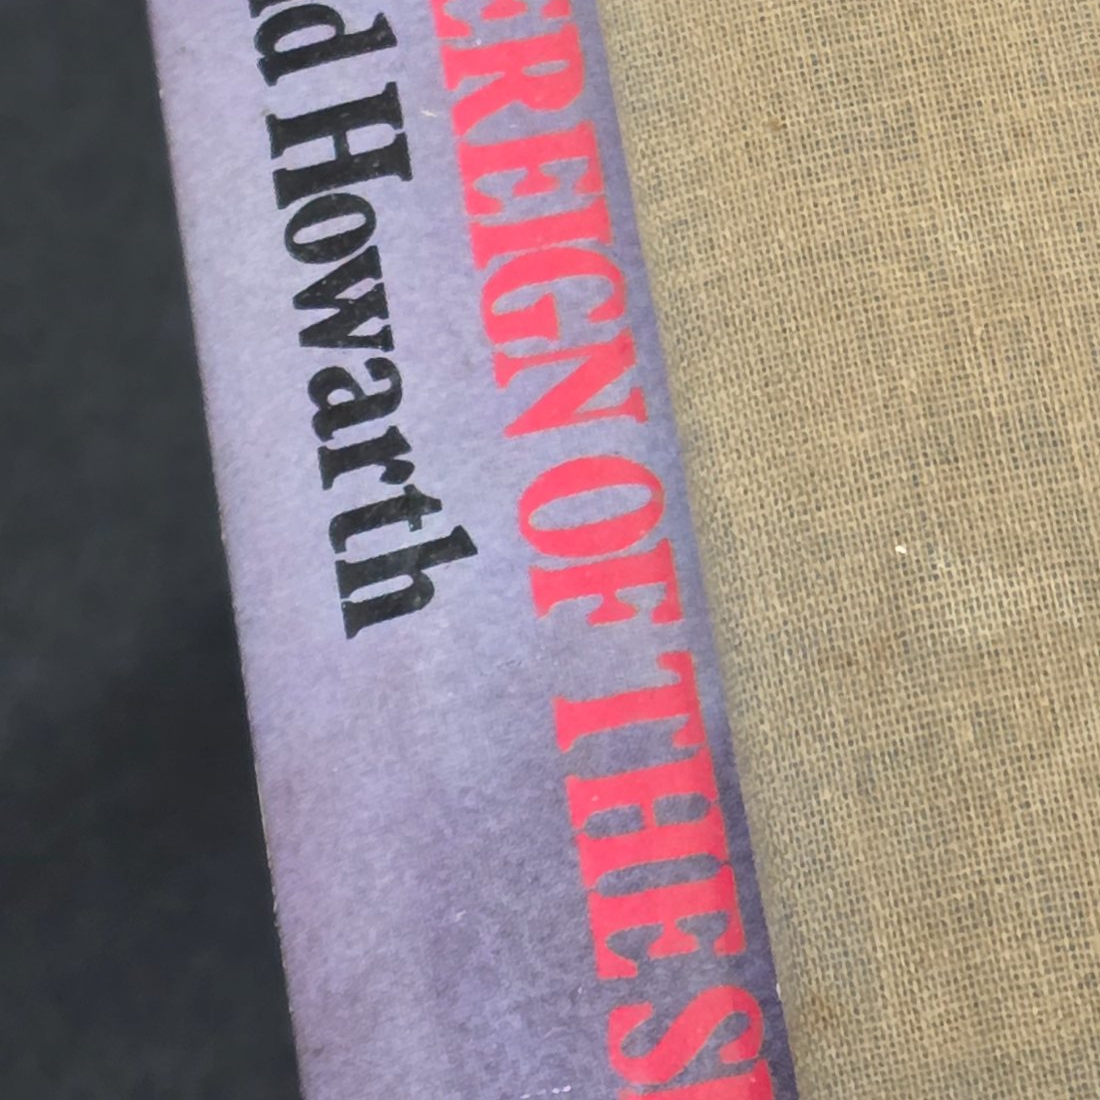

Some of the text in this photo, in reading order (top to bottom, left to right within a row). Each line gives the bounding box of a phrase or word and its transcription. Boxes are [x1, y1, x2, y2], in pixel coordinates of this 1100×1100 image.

[265, 81, 477, 640] Howarth
[517, 454, 684, 626] OF
[551, 649, 746, 981] THE
